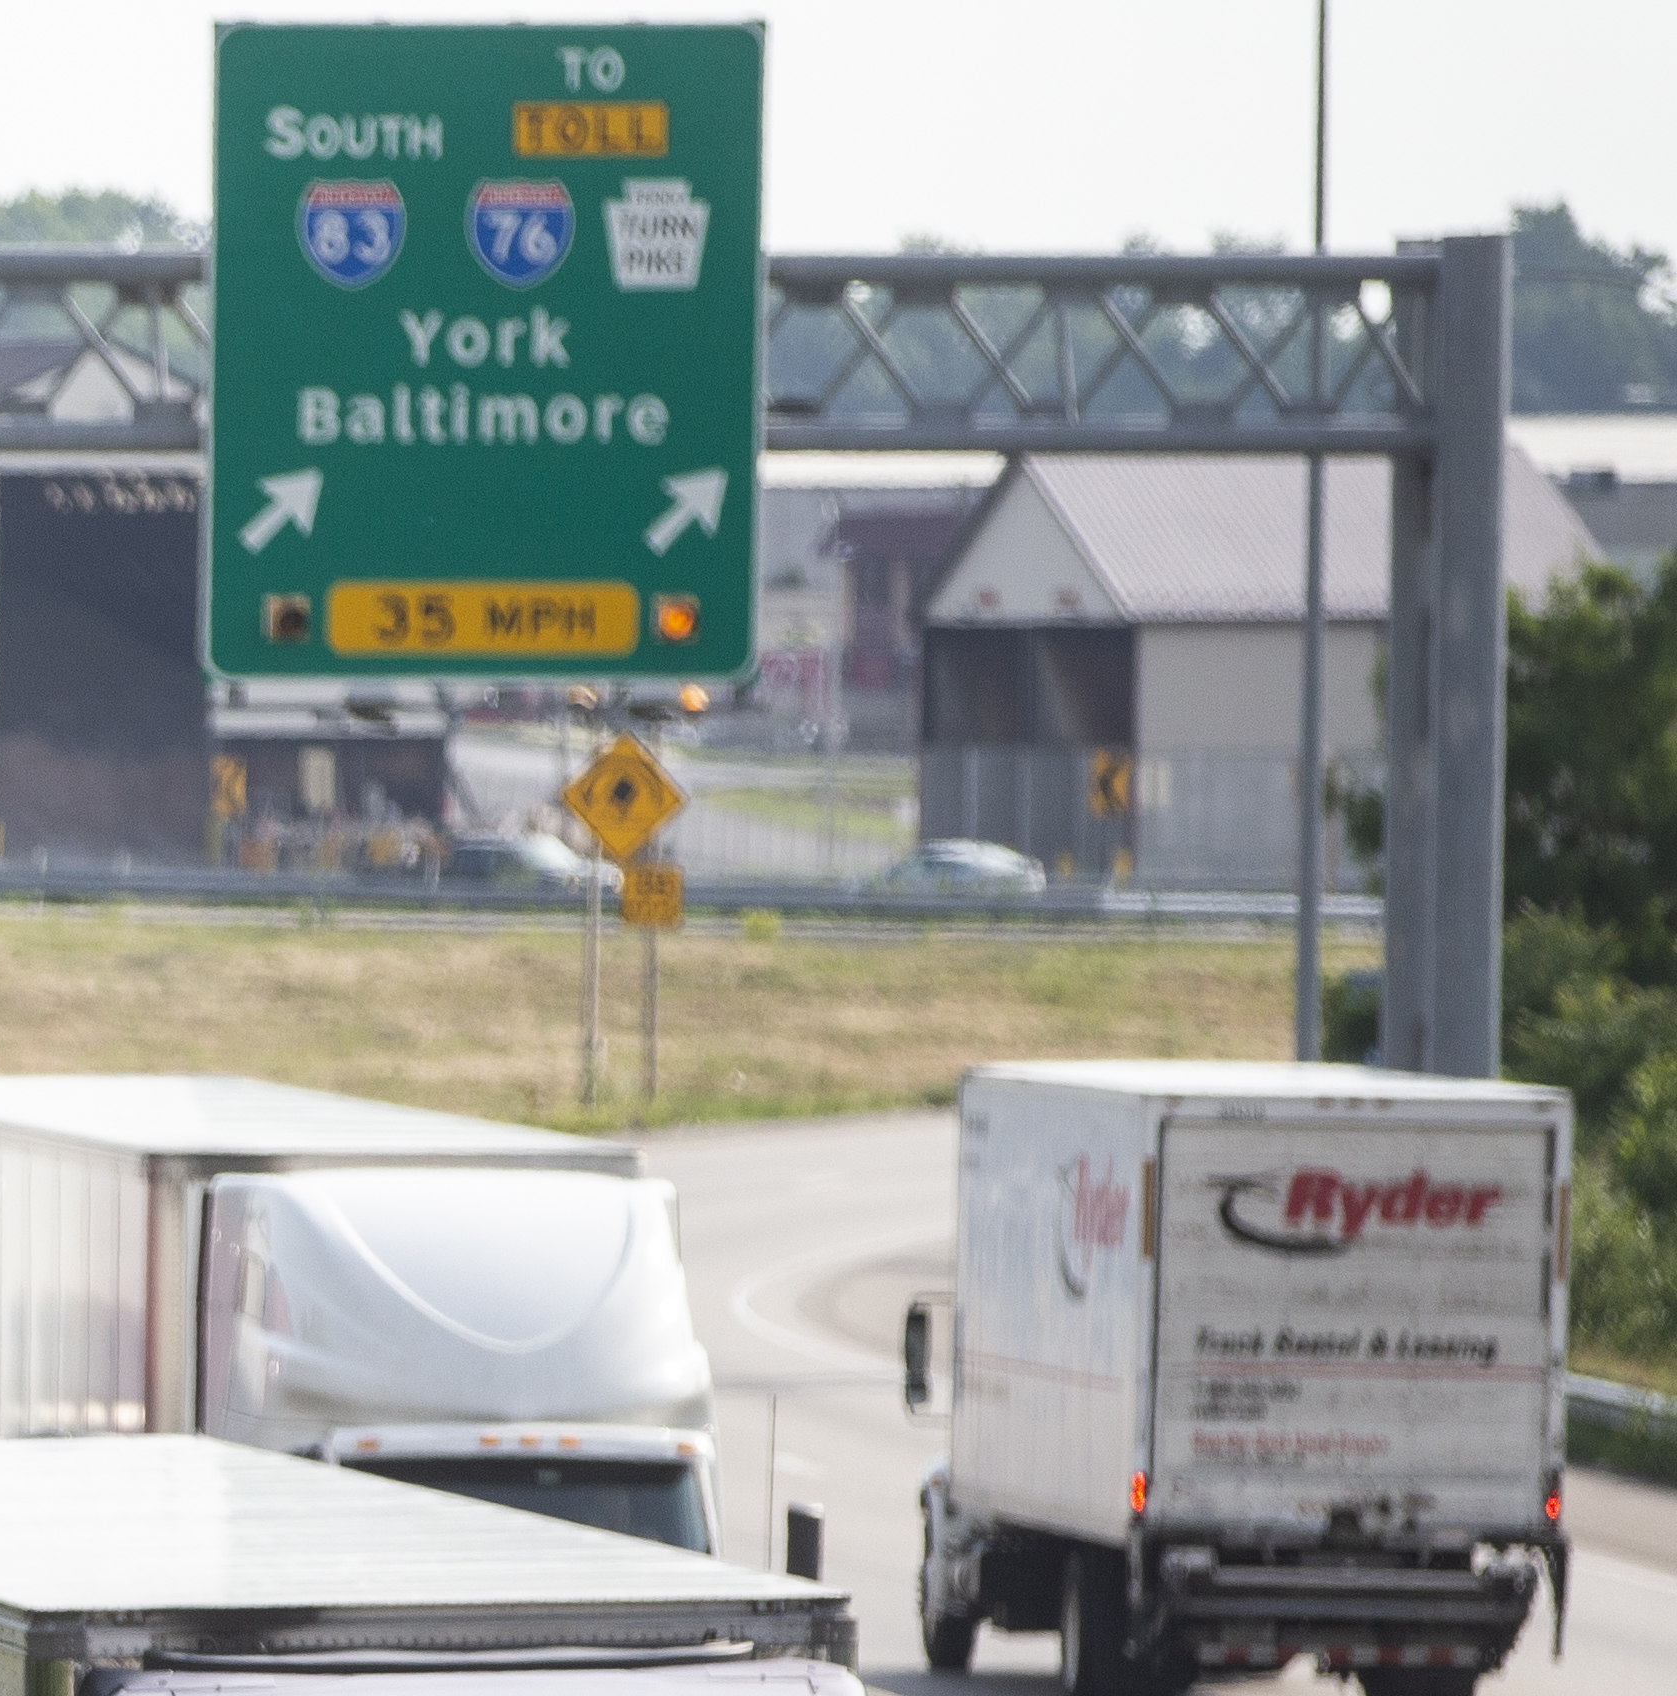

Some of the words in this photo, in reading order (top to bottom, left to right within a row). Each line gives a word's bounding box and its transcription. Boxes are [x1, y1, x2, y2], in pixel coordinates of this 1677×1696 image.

[556, 46, 626, 92] TO
[264, 104, 444, 160] SOUTH
[522, 104, 664, 152] TOLL
[310, 209, 392, 265] 83
[483, 209, 559, 265] 76
[622, 213, 699, 239] TURN
[626, 249, 687, 275] PIKE
[398, 306, 571, 367] York
[295, 383, 671, 445] Baltimore
[371, 593, 458, 645] 35
[481, 599, 597, 640] MPH
[1284, 1166, 1502, 1244] Ryder
